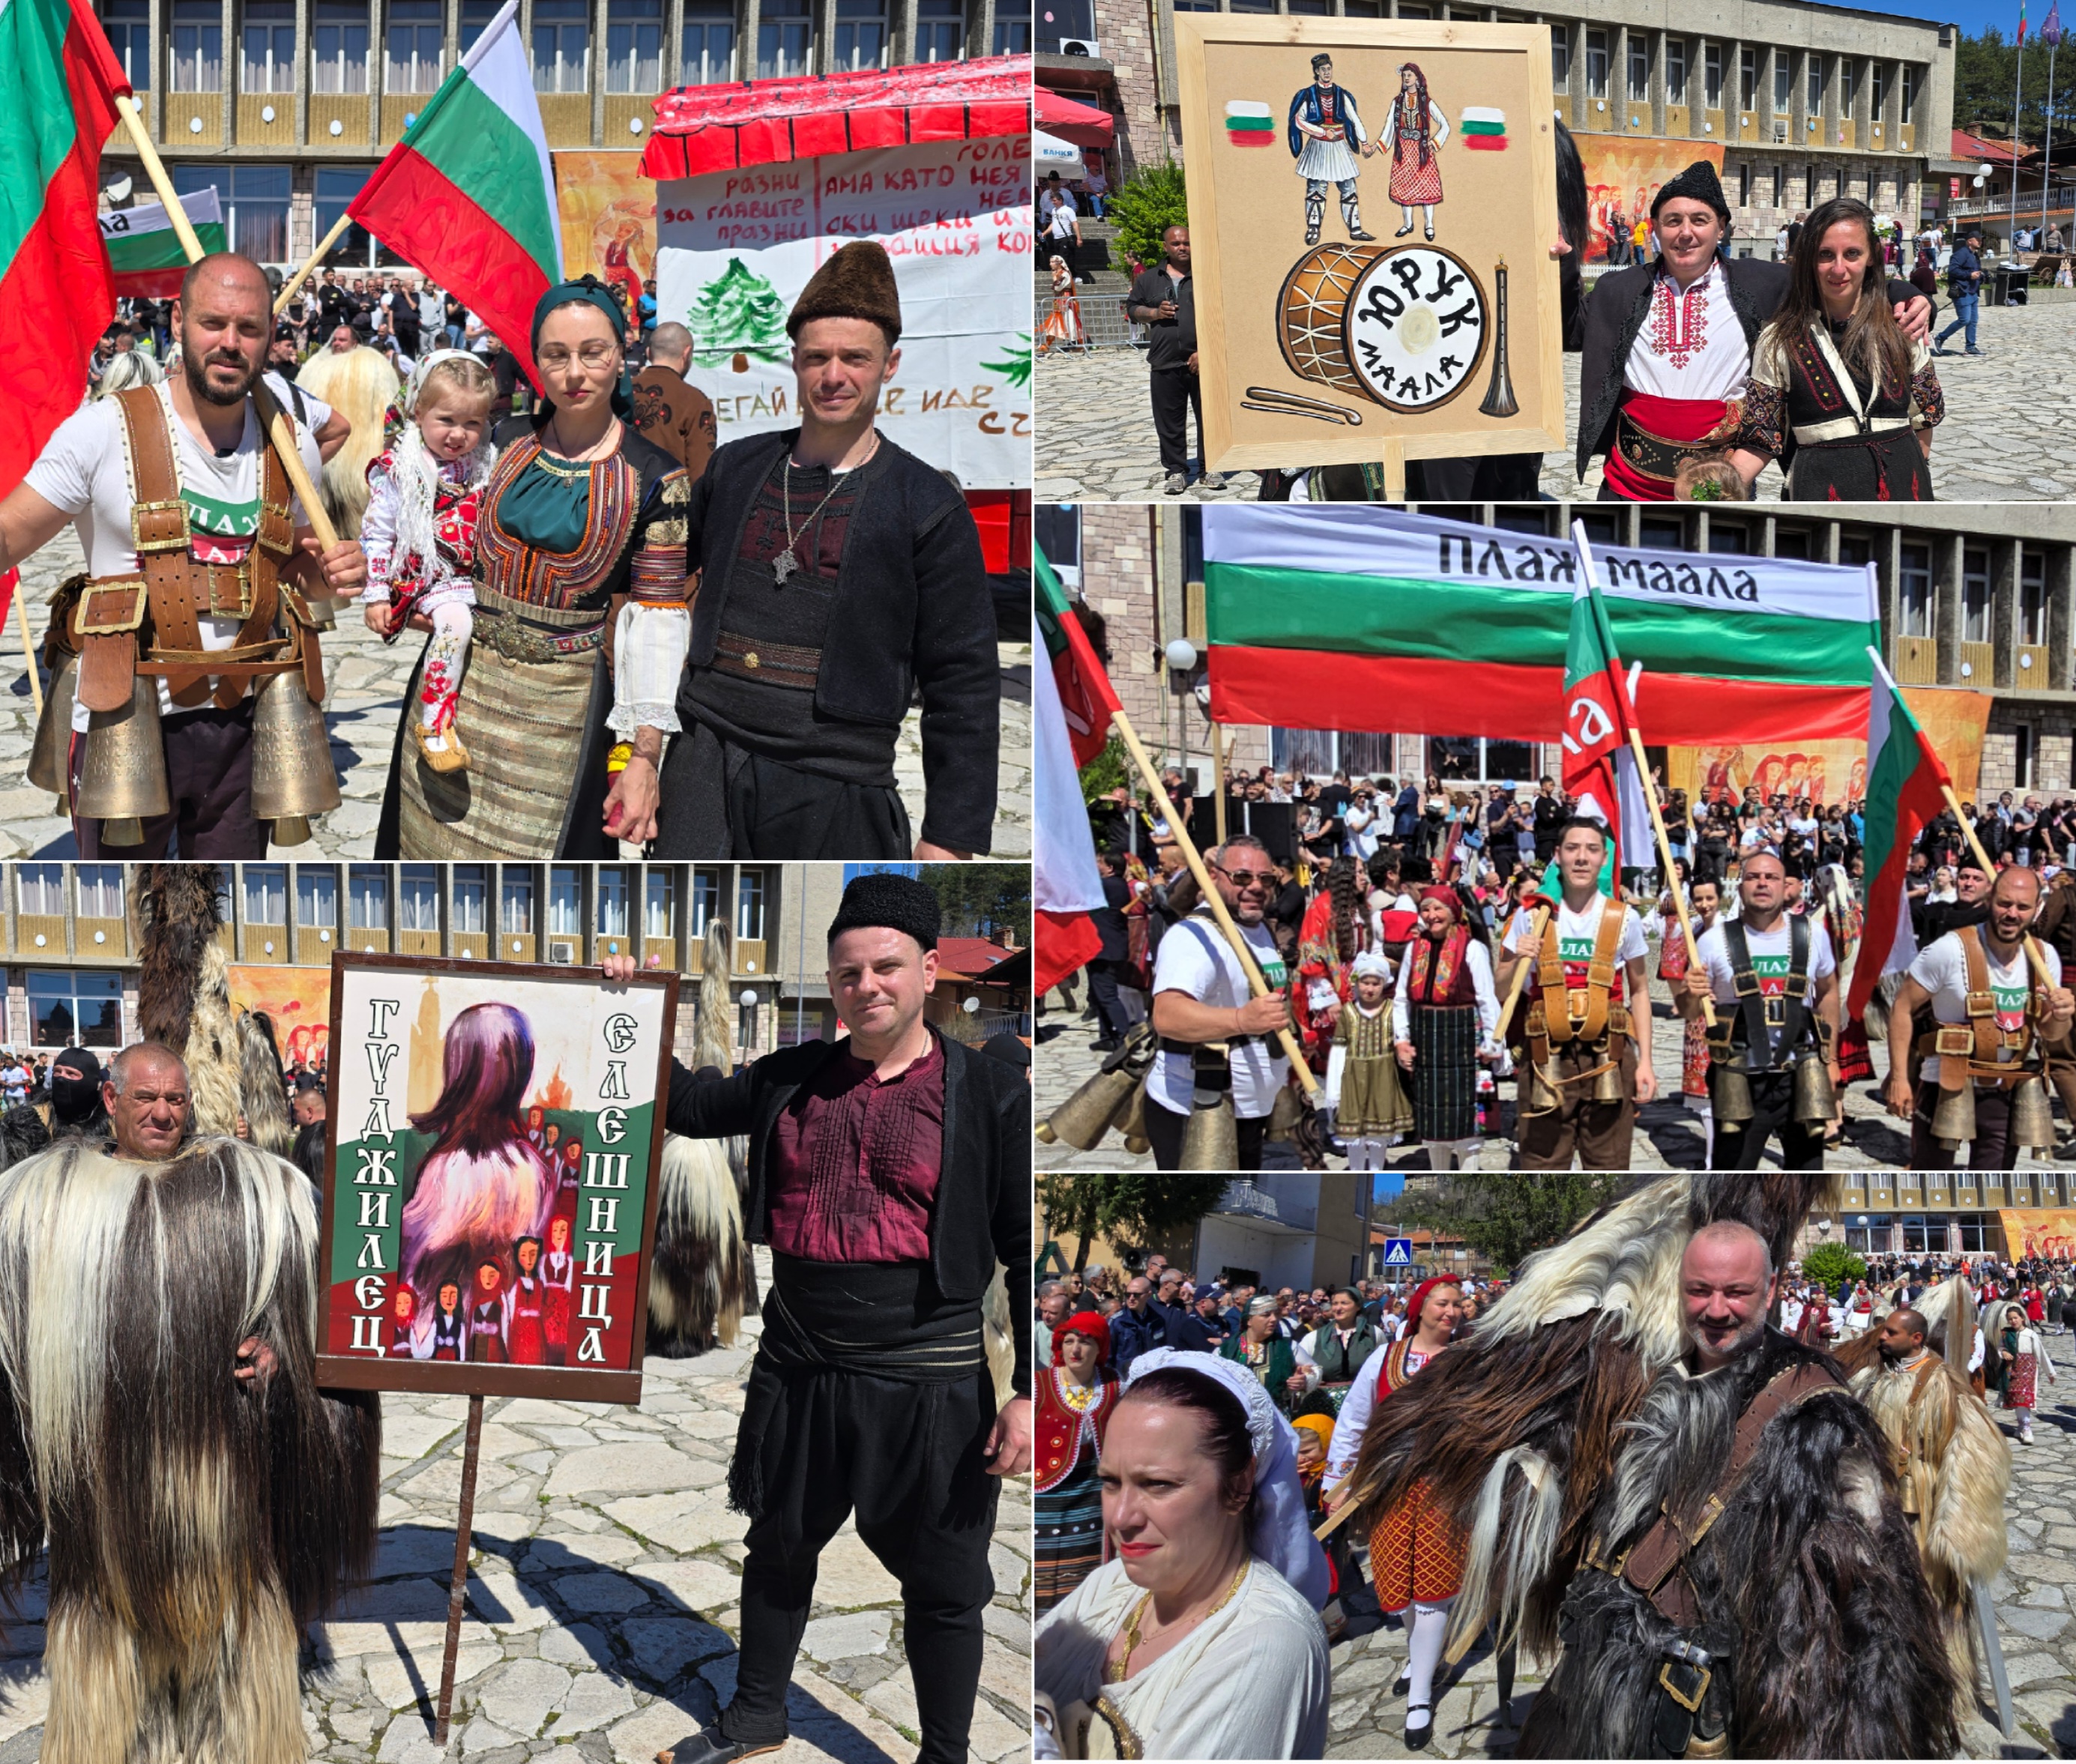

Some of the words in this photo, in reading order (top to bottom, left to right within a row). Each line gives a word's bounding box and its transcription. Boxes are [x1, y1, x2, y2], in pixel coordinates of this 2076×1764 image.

[1042, 148, 1073, 157] БАНКЯ
[825, 171, 874, 197] АМА
[884, 165, 955, 191] КАТО
[970, 165, 1022, 186] НЕЯ
[1357, 258, 1479, 338] ЮРУК
[1357, 339, 1464, 400] МААЛА
[711, 385, 787, 421] ЕГАЙ
